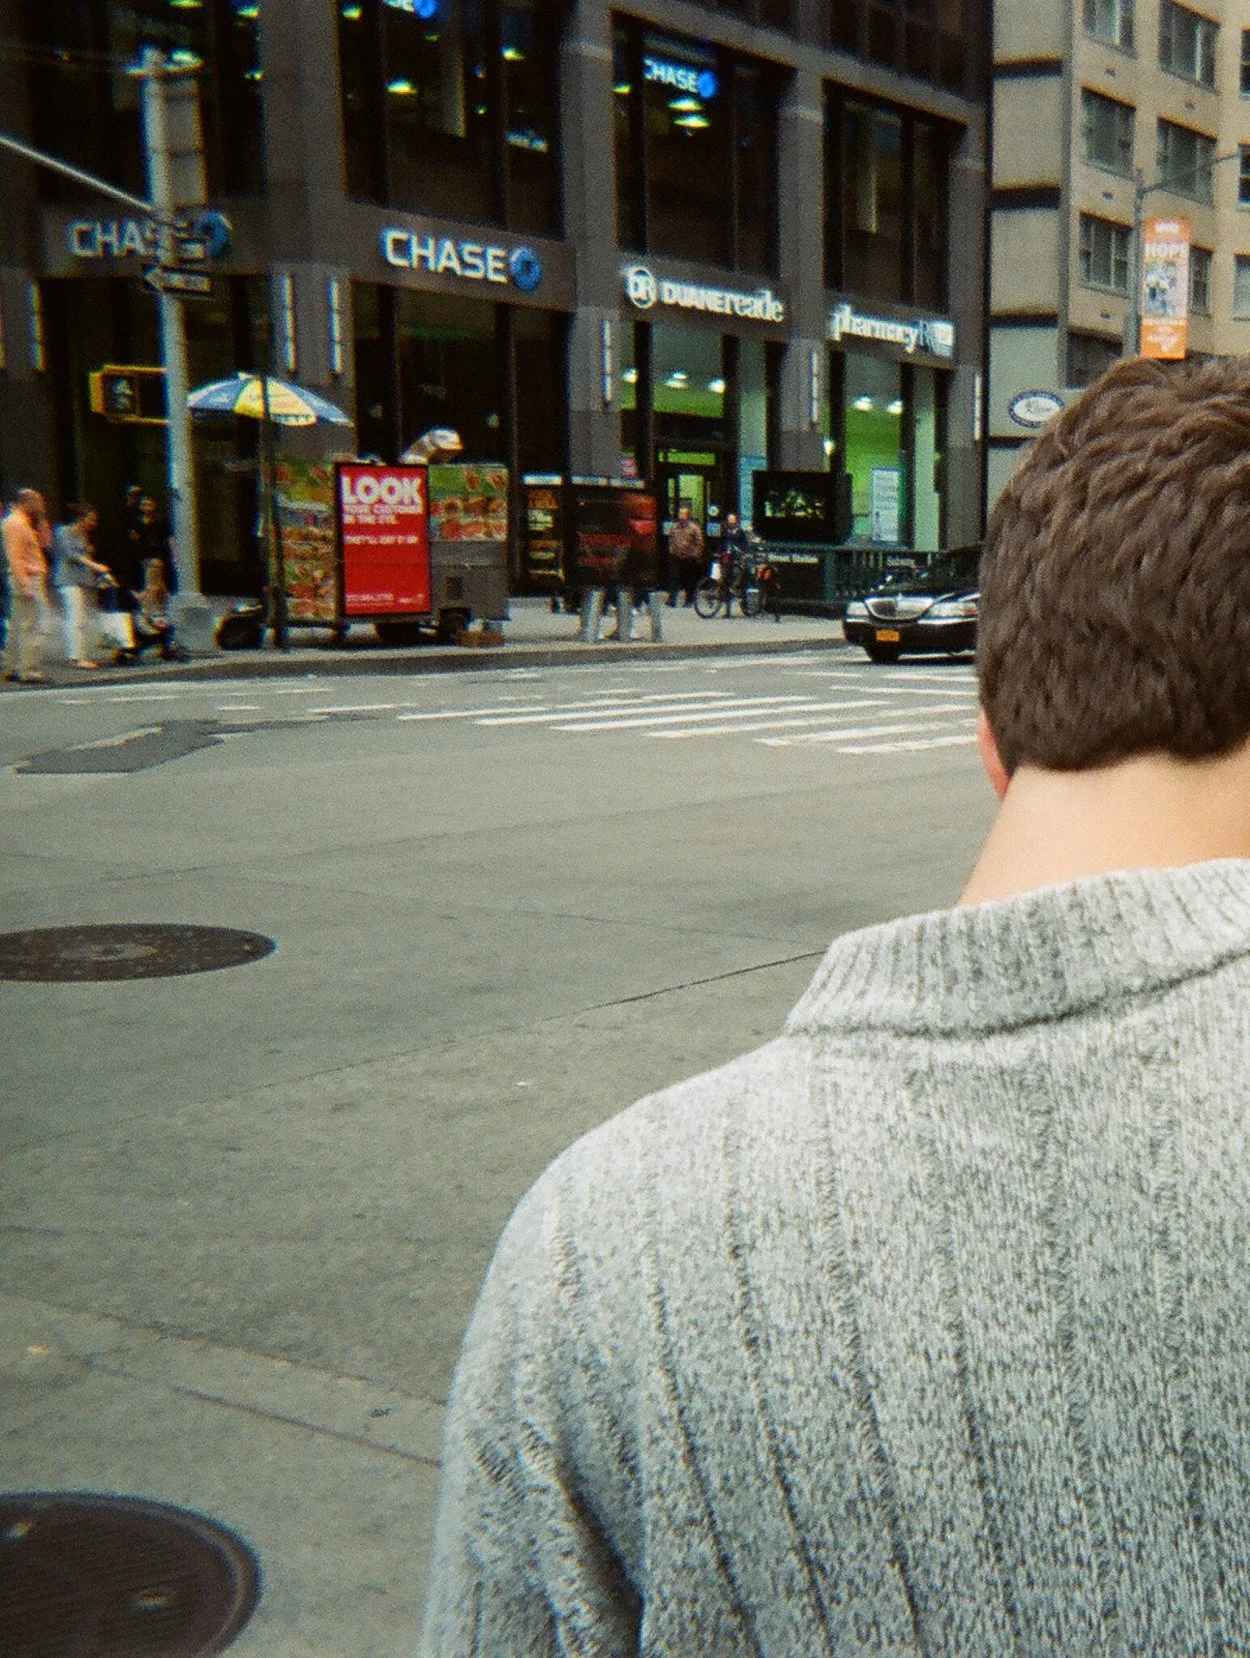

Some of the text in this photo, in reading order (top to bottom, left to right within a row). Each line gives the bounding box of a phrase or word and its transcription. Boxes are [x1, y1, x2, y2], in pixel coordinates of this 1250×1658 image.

[380, 229, 508, 284] CHASE
[829, 302, 919, 354] pharmacy
[341, 475, 423, 505] LOOK
